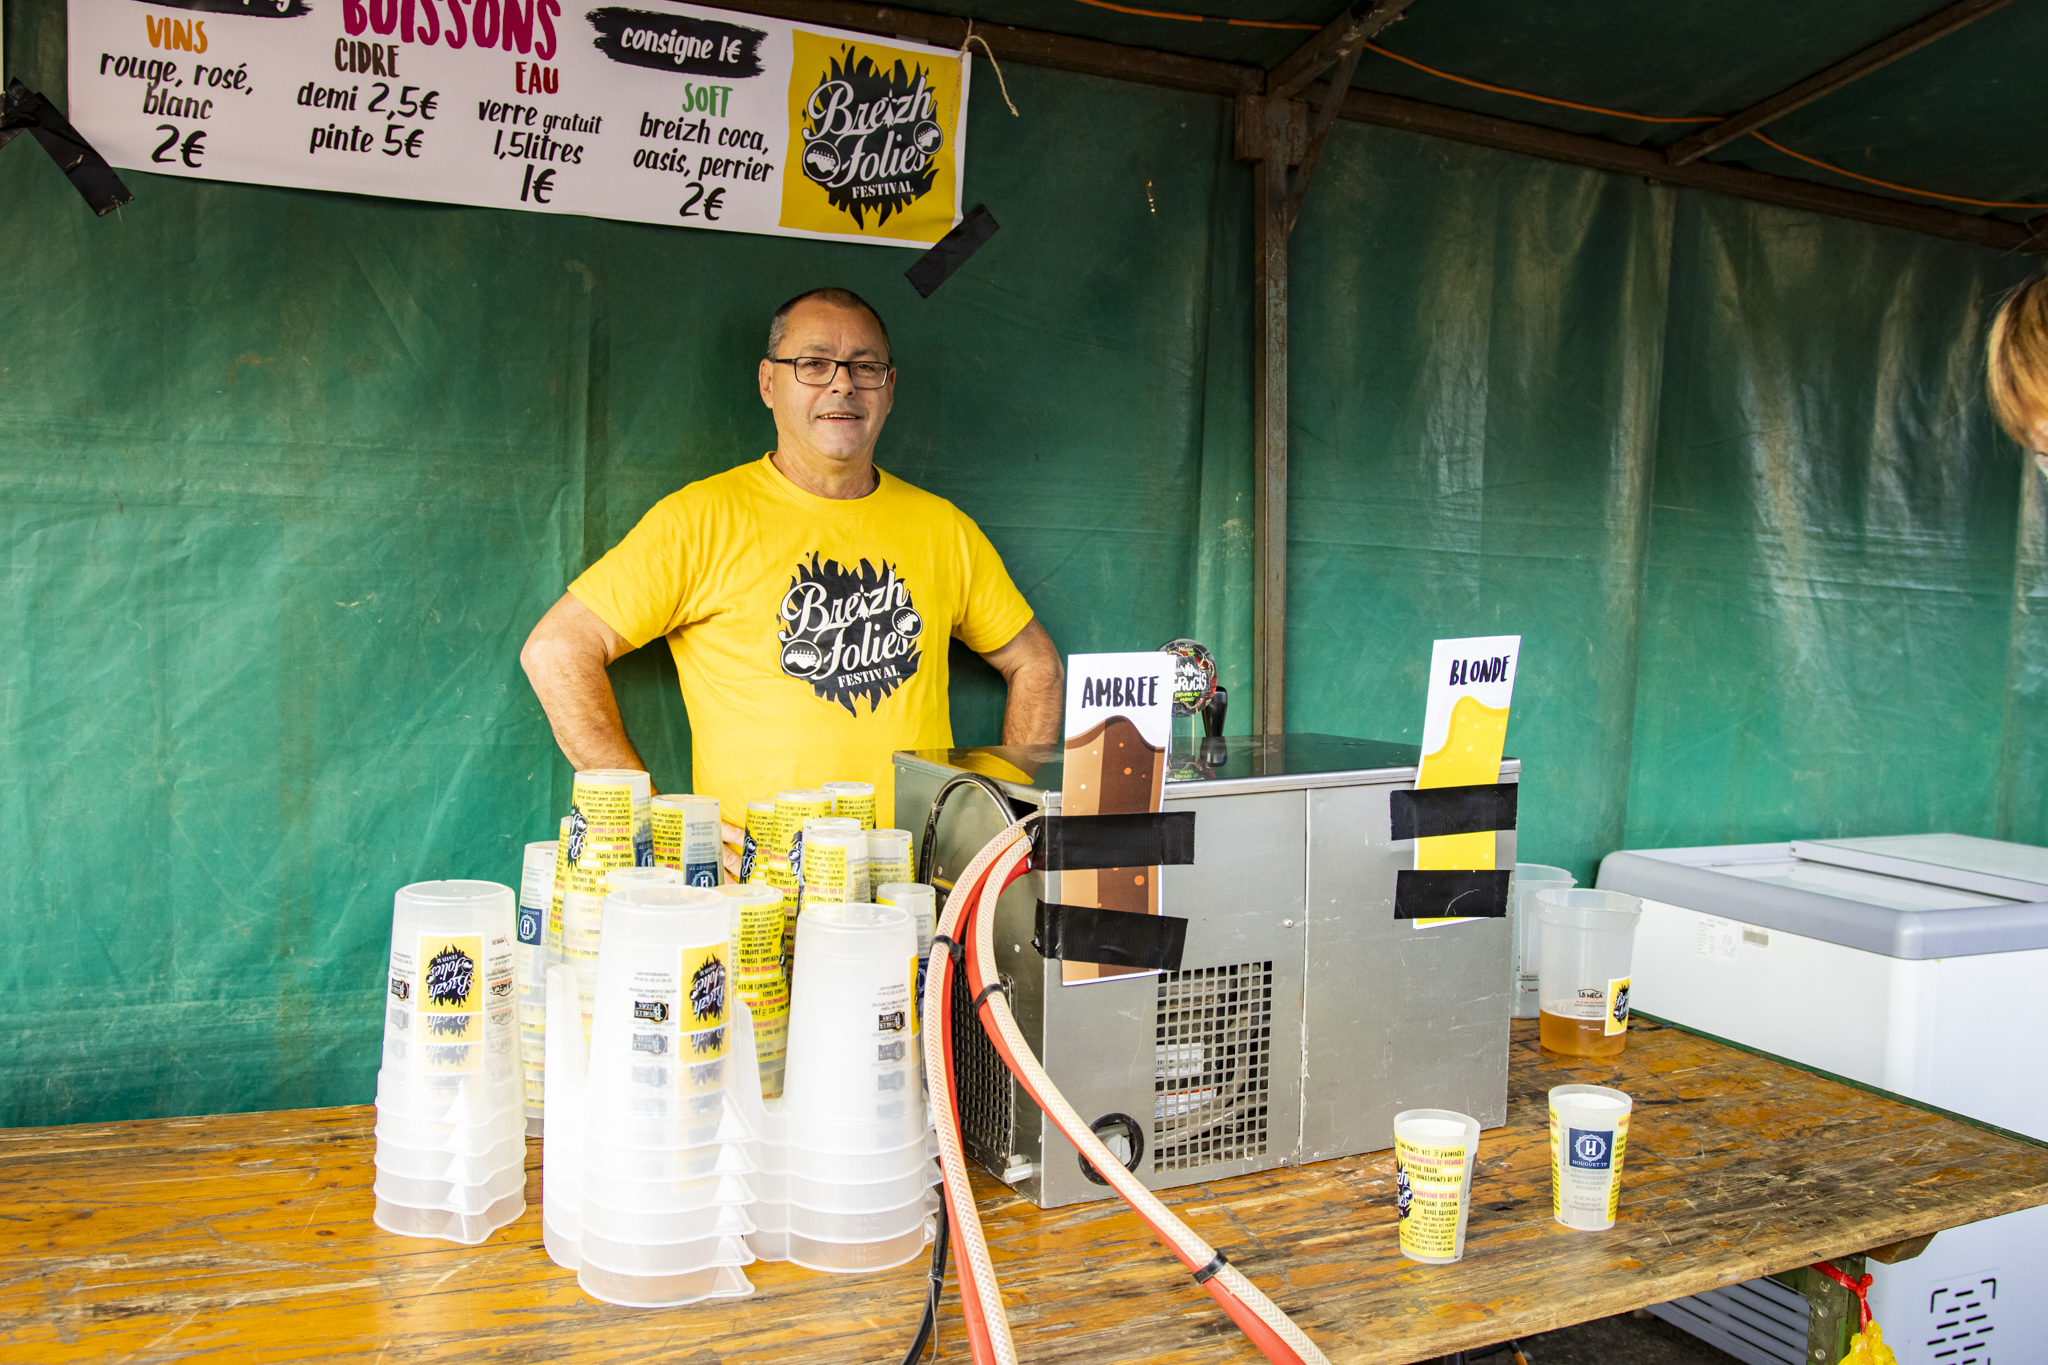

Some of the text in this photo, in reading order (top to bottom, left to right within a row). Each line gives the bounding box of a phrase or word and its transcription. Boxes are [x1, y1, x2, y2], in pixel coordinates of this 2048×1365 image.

[146, 14, 208, 54] VINS
[342, 0, 561, 60] BOISSONS
[620, 26, 742, 65] consigne 1€
[99, 52, 254, 95] rouge, rosé,
[334, 37, 400, 78] CIDRE
[515, 61, 559, 95] EAU
[142, 81, 214, 119] blanc
[297, 82, 440, 120] demi 2,5€
[478, 99, 603, 134] verre gratuit
[682, 82, 734, 118] SOFT
[802, 75, 938, 141] Breizh
[151, 123, 207, 168] 2€
[309, 123, 425, 158] pinte 5€
[493, 129, 584, 164] 1,5litres
[639, 111, 769, 155] breizh coca,
[633, 148, 774, 182] oasis, perrier
[520, 164, 556, 204] 1€
[680, 182, 726, 221] 2€
[851, 180, 914, 199] FESTIVAL
[778, 569, 910, 642] Breizh
[837, 664, 900, 688] FESTIVAL
[1449, 655, 1511, 686] BLONDE
[1081, 675, 1160, 709] AMBREE
[522, 920, 531, 935] H
[429, 972, 474, 1003] Breizh
[1572, 1159, 1600, 1168] HOUGUET
[1585, 1140, 1598, 1156] H
